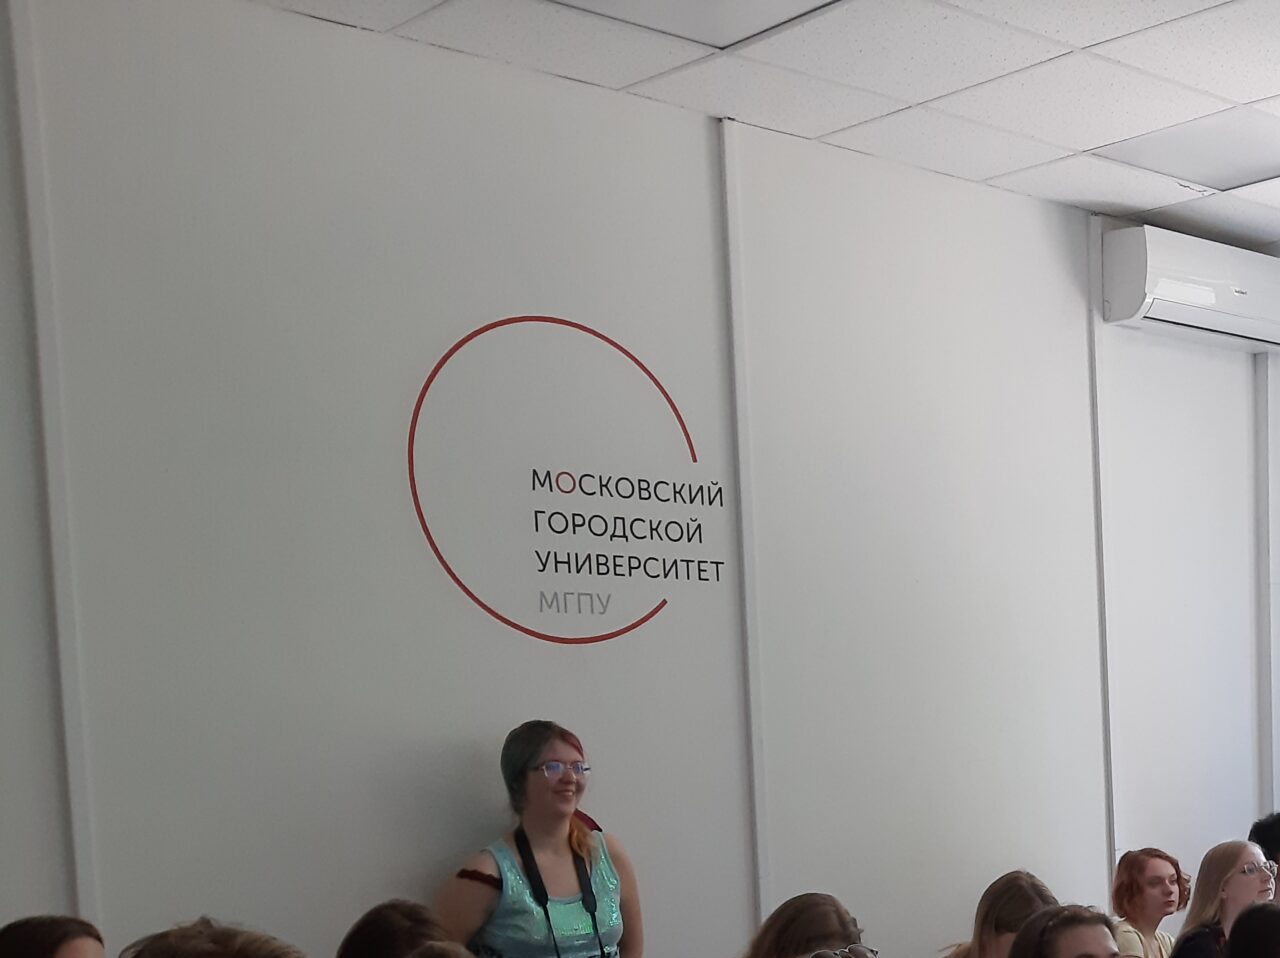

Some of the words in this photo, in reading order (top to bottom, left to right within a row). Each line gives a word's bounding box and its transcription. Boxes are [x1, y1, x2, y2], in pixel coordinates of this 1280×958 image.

[531, 468, 724, 507] МОСКОВСКИЙ
[533, 510, 703, 544] ГОРОДСКОЙ
[534, 550, 725, 582] УНИВЕРСИТЕТ
[539, 590, 611, 615] МГПУ
